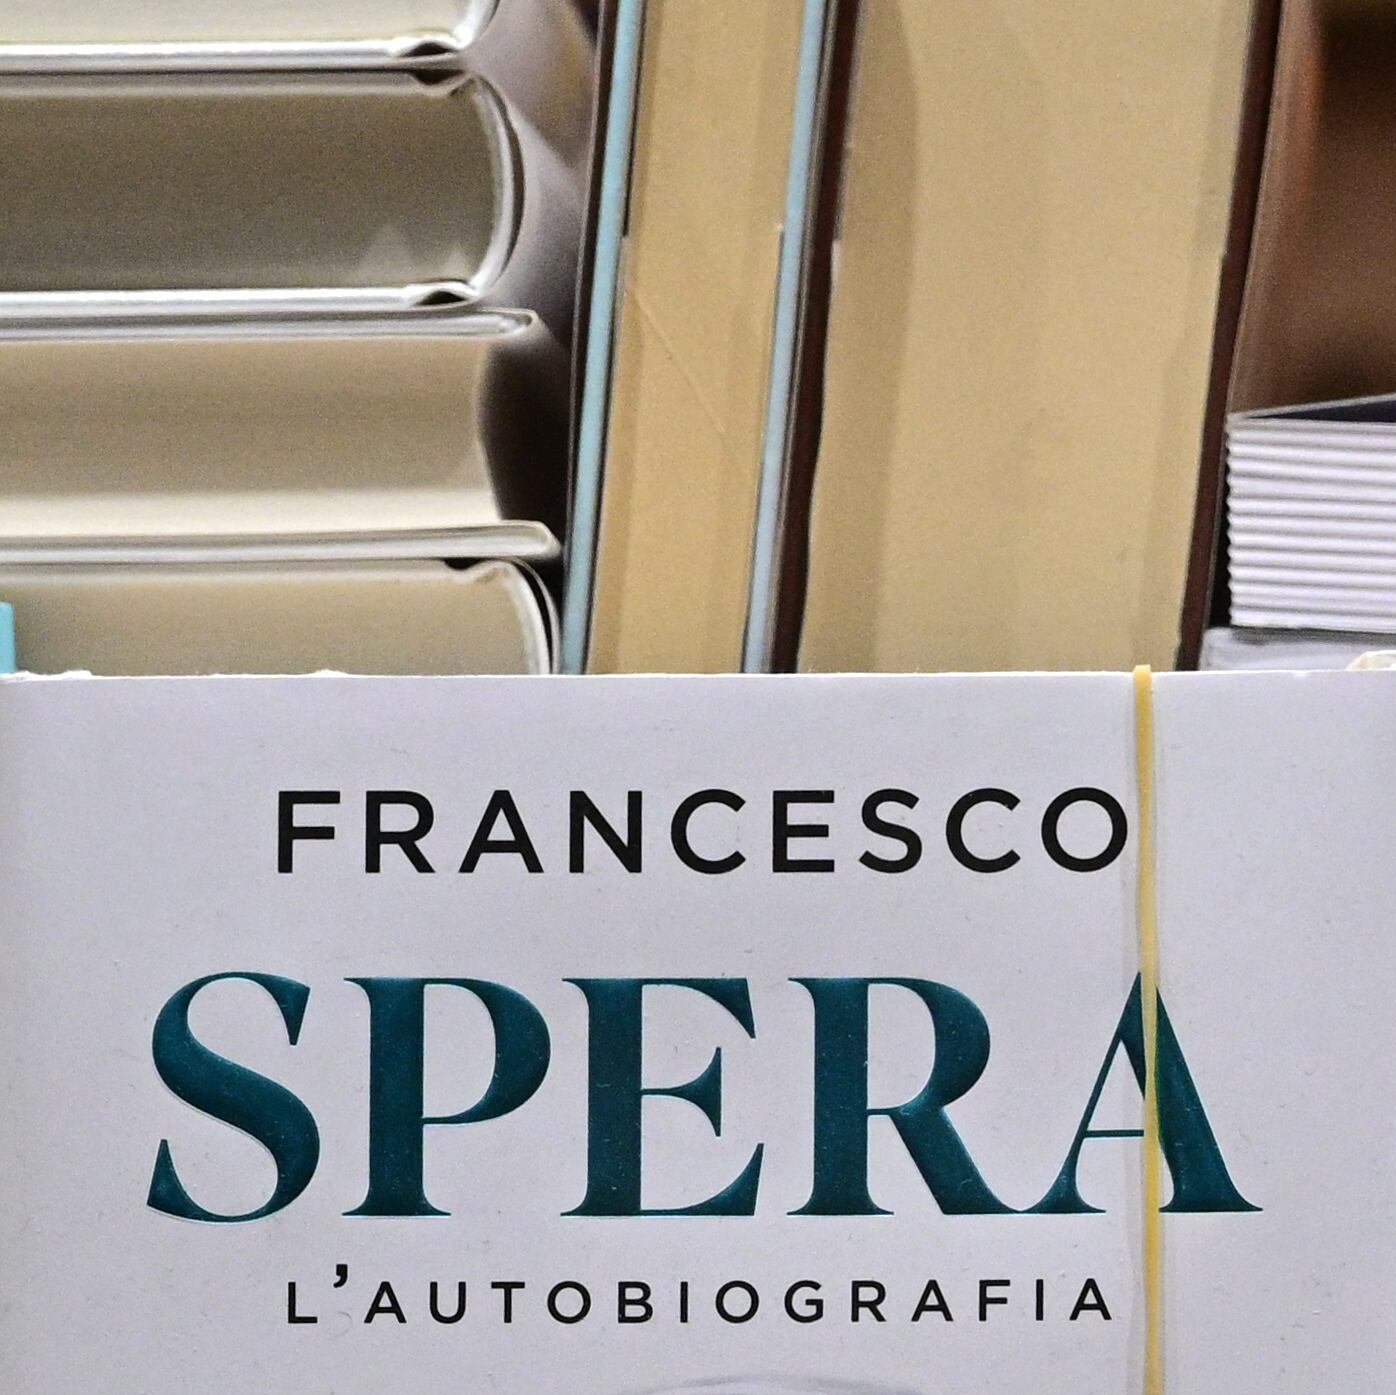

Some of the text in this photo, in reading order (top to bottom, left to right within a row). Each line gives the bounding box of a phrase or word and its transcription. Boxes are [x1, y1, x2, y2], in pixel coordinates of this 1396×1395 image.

[278, 788, 1127, 874] FRANCESCO
[147, 972, 1263, 1222] SPERA
[288, 1264, 1111, 1324] L’AUTOBIOGRAFIA
